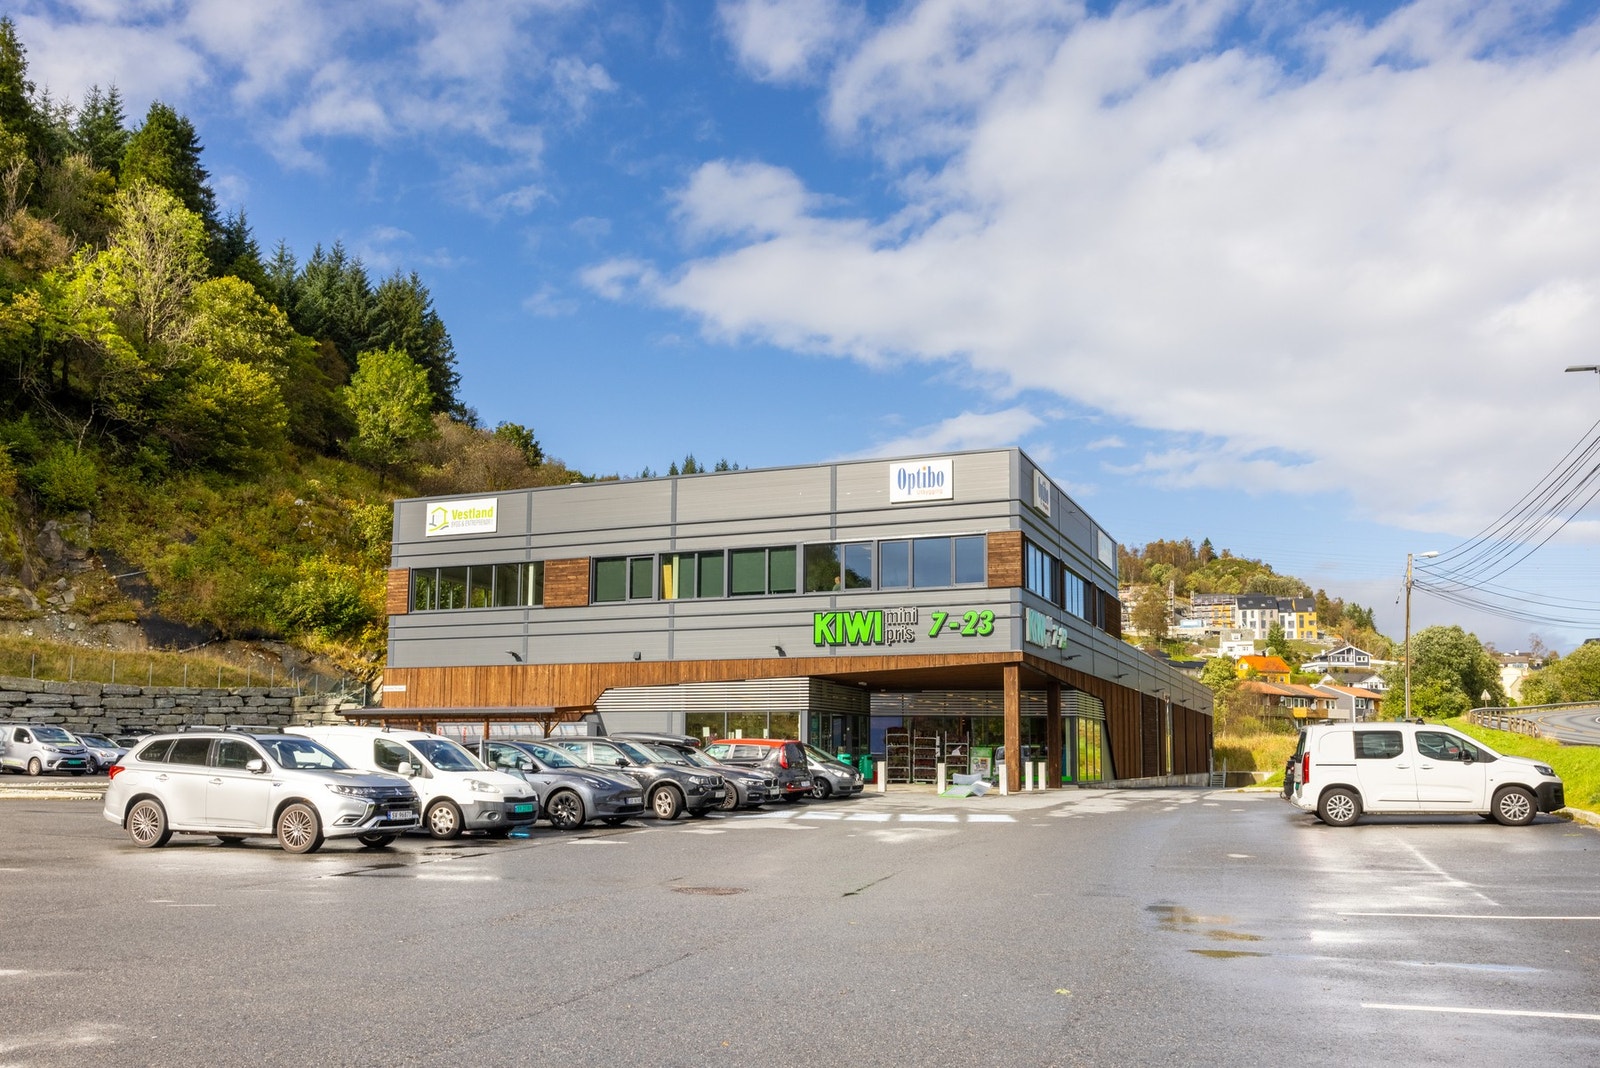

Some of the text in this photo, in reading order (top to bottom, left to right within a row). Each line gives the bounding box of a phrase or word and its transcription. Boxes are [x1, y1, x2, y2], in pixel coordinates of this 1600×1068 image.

[898, 465, 944, 495] Optibo
[452, 506, 493, 520] Vestland
[886, 607, 918, 624] mini
[813, 610, 884, 645] KIWI
[886, 626, 916, 646] pris
